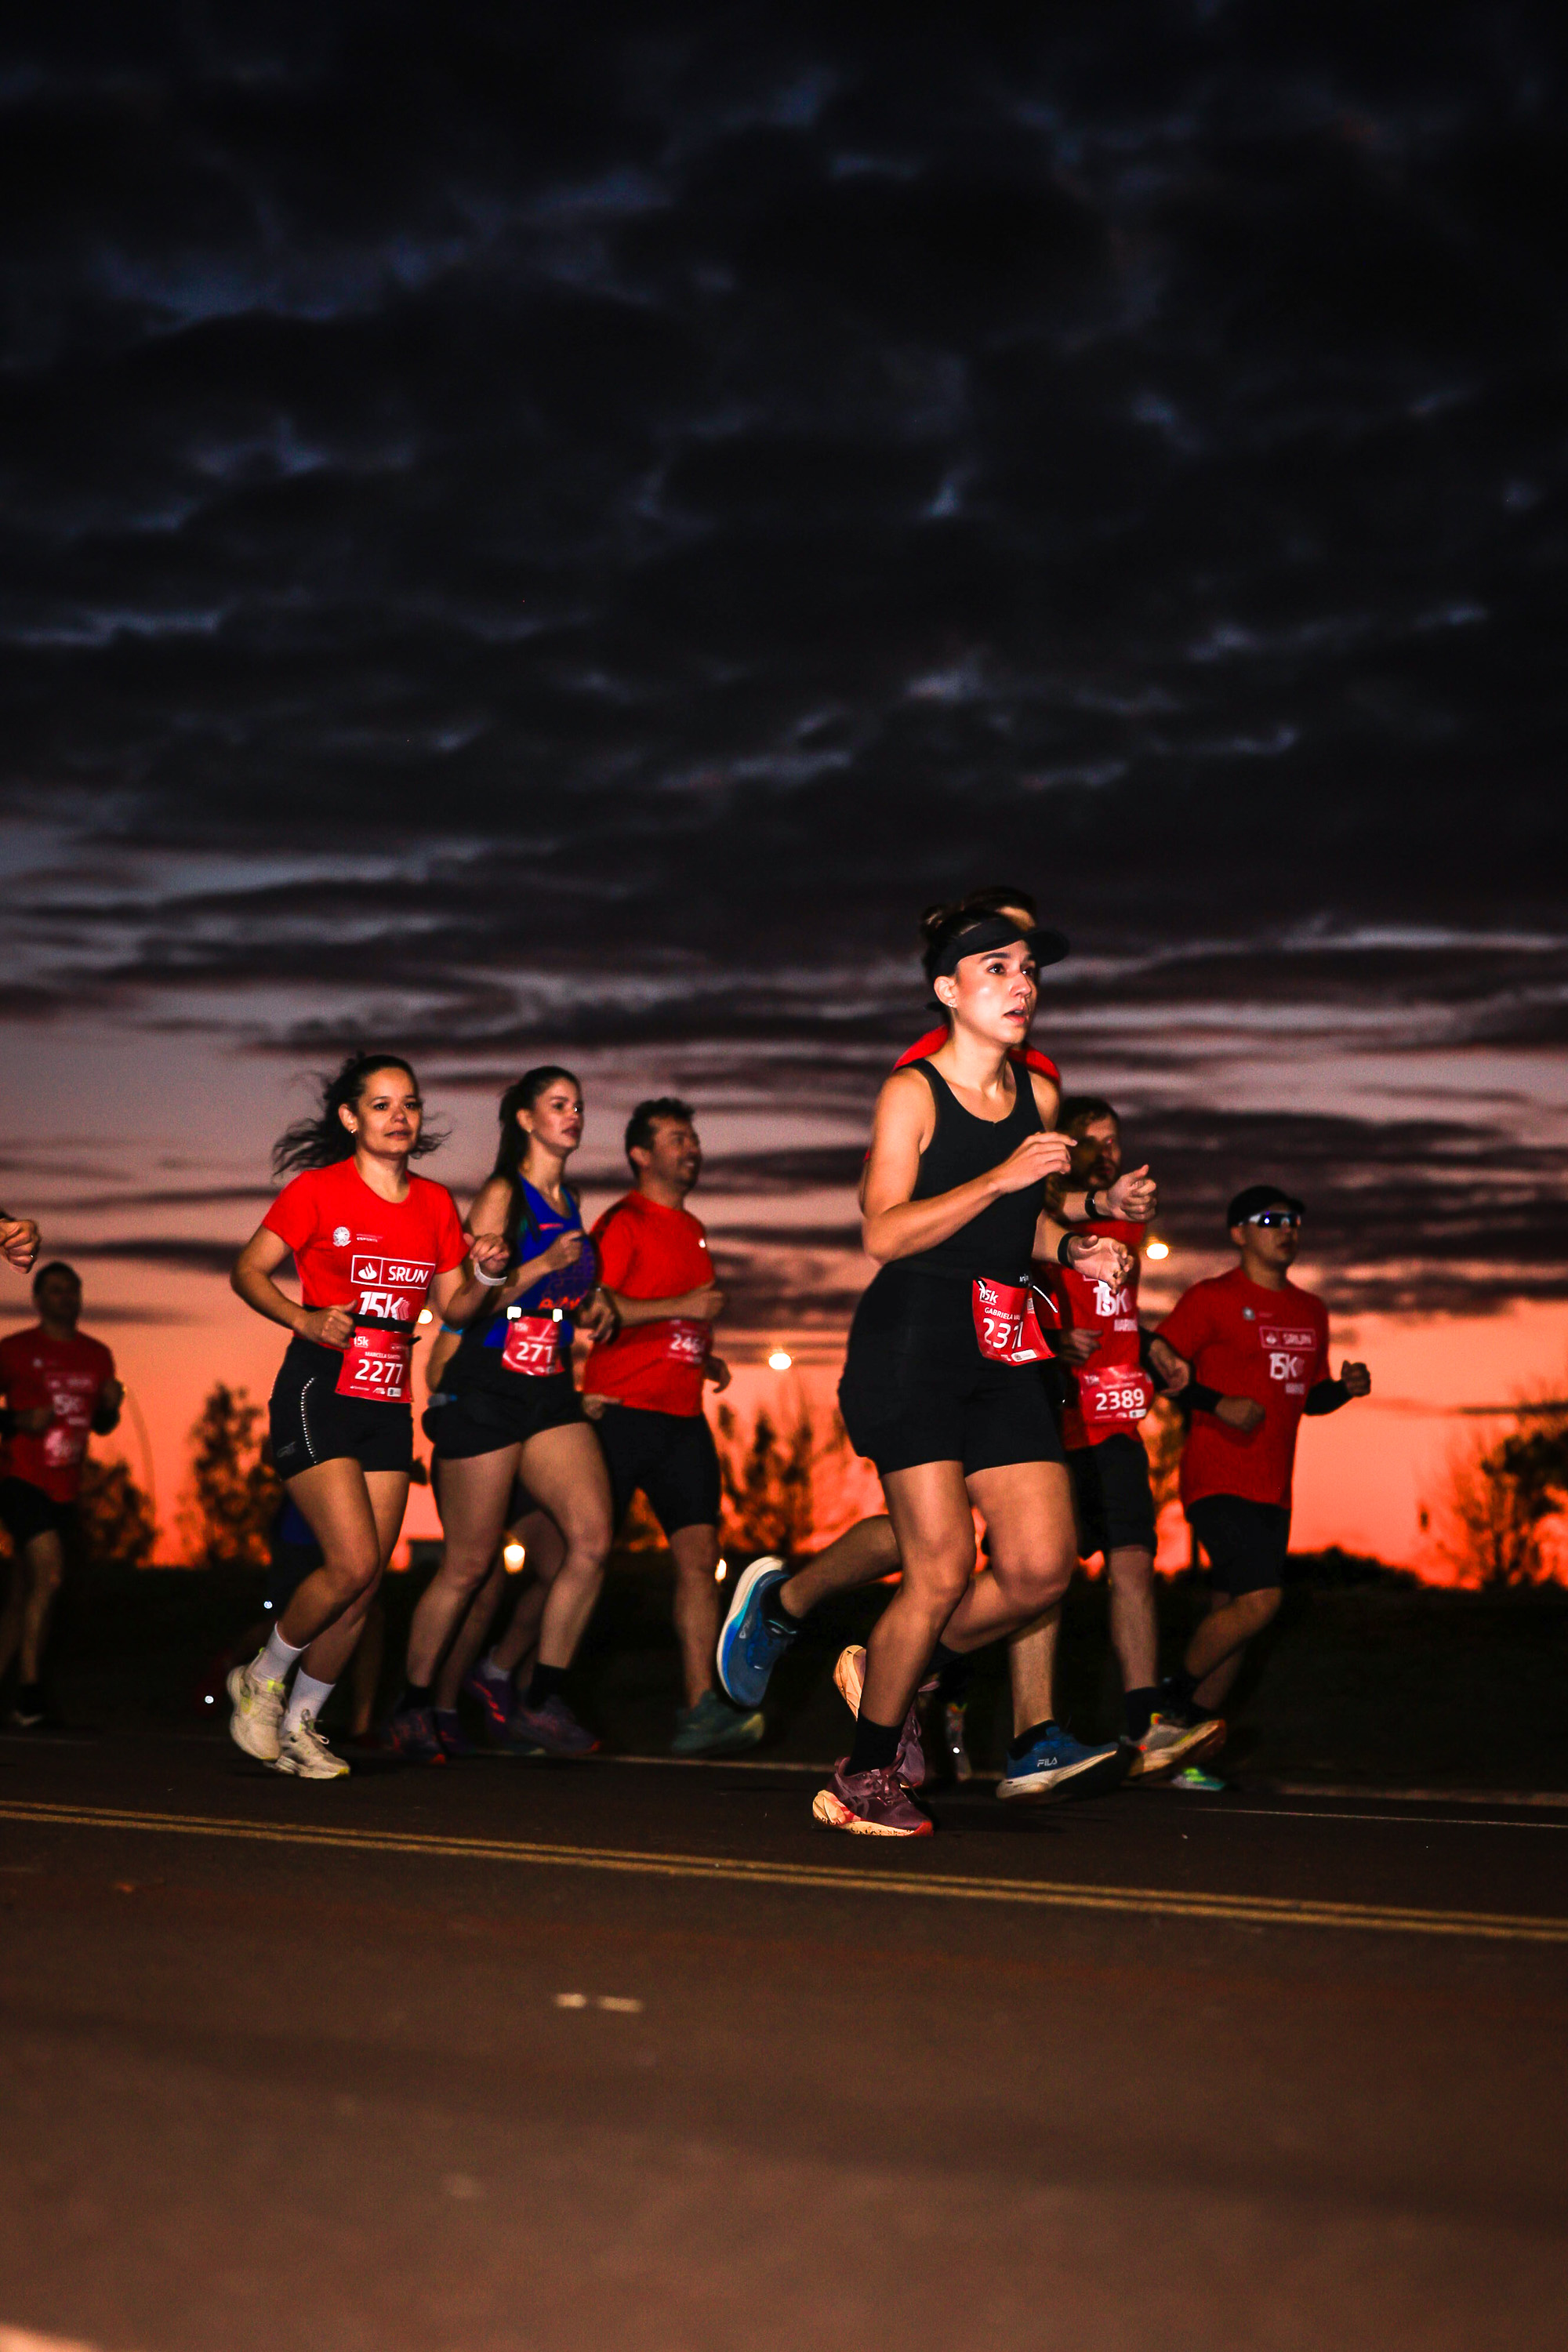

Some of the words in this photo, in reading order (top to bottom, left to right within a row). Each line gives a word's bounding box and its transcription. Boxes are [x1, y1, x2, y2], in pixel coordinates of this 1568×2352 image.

[387, 1265, 429, 1283] SRUN
[978, 1287, 999, 1304] 15k
[358, 1291, 404, 1320] 15K
[984, 1307, 1013, 1319] GABRIELA
[354, 1359, 403, 1385] 2277
[1095, 1388, 1145, 1411] 2389
[1036, 1757, 1058, 1767] FILA
